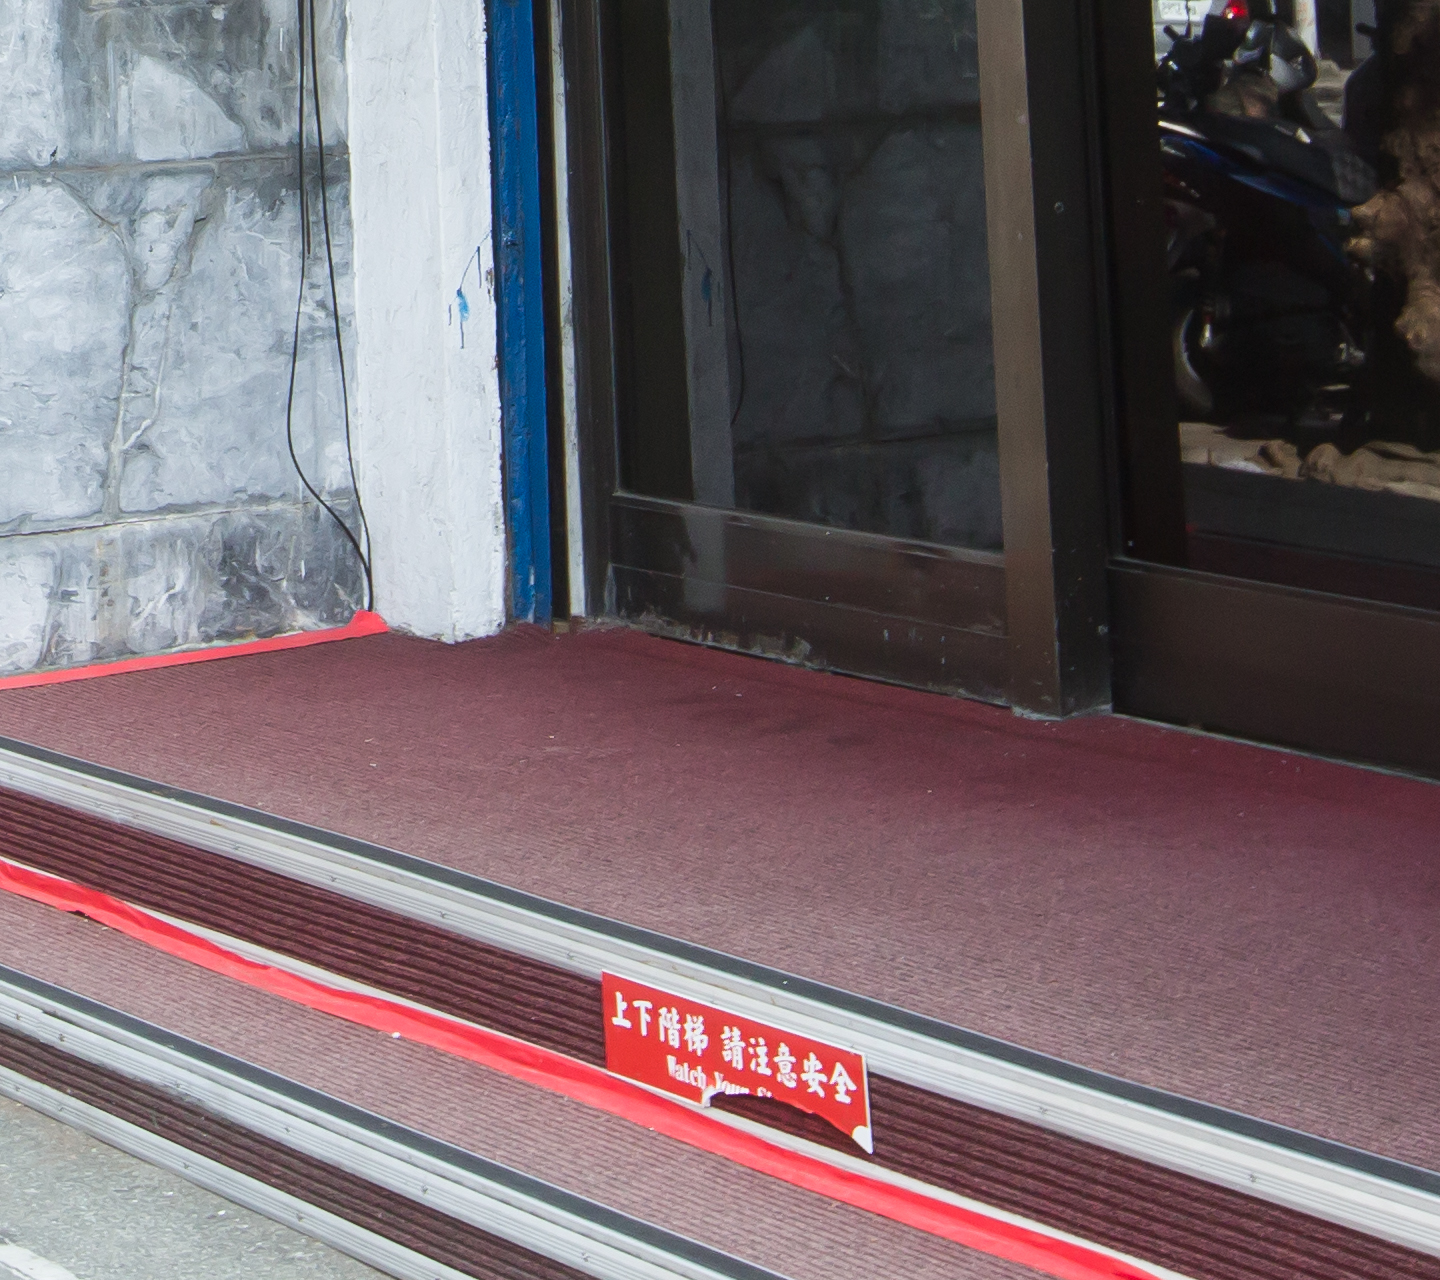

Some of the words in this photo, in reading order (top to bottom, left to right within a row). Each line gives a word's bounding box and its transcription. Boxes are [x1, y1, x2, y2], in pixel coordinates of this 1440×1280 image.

[611, 991, 709, 1057] 上下階梯
[720, 1026, 858, 1104] 請注意安全
[666, 1054, 707, 1091] Watch
